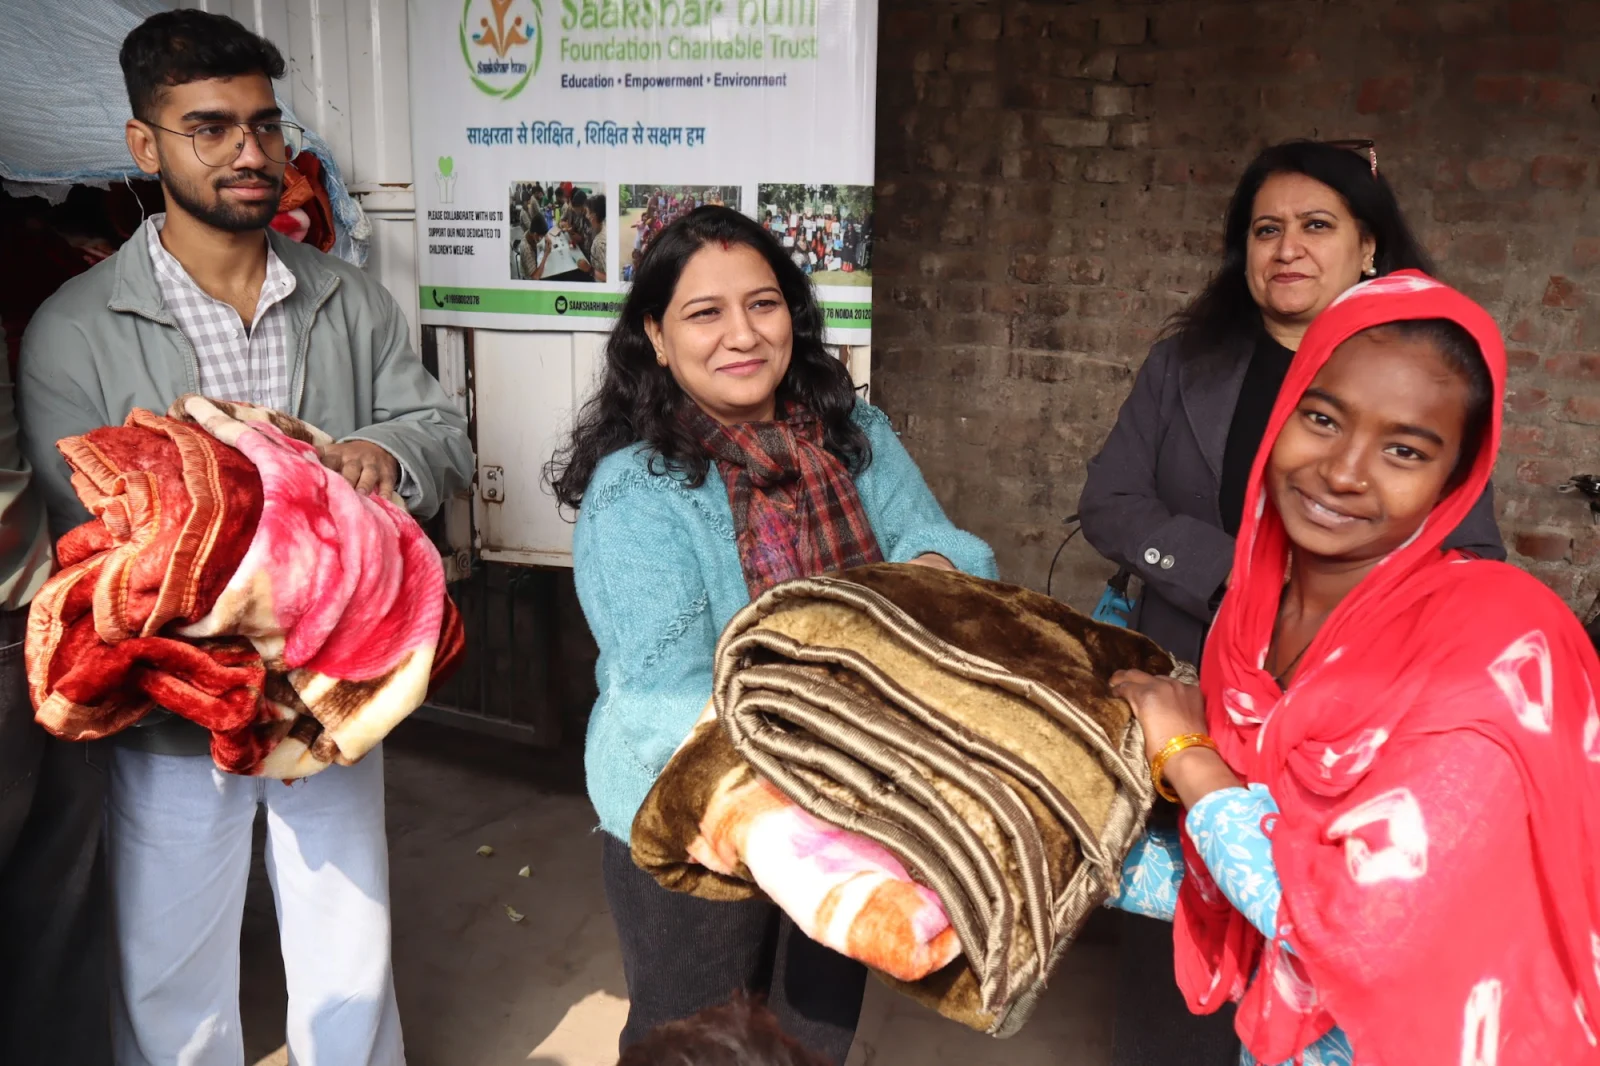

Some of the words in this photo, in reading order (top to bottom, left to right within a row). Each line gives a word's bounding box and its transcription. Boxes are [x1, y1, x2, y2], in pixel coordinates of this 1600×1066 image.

[561, 35, 662, 62] Foundation
[668, 34, 764, 61] Charitable
[769, 33, 818, 61] Trust
[561, 74, 614, 88] Education
[625, 73, 703, 91] Empowerment
[714, 72, 787, 87] Environment
[467, 127, 513, 146] साक्षरता
[517, 122, 528, 145] से
[585, 120, 628, 145] शिक्षित
[632, 121, 643, 145] से
[647, 127, 682, 146] सक्षम
[686, 127, 705, 146] हम
[428, 210, 443, 220] PLEASE
[443, 210, 474, 220] COLLABORATE
[475, 211, 488, 220] WITH
[489, 211, 496, 221] US
[497, 211, 503, 221] TO
[428, 228, 446, 237] SUPPORT
[447, 228, 455, 237] OUR
[466, 228, 493, 238] DEDICATED
[494, 229, 501, 238] TO
[826, 308, 834, 319] 76
[835, 308, 853, 320] NOIDA
